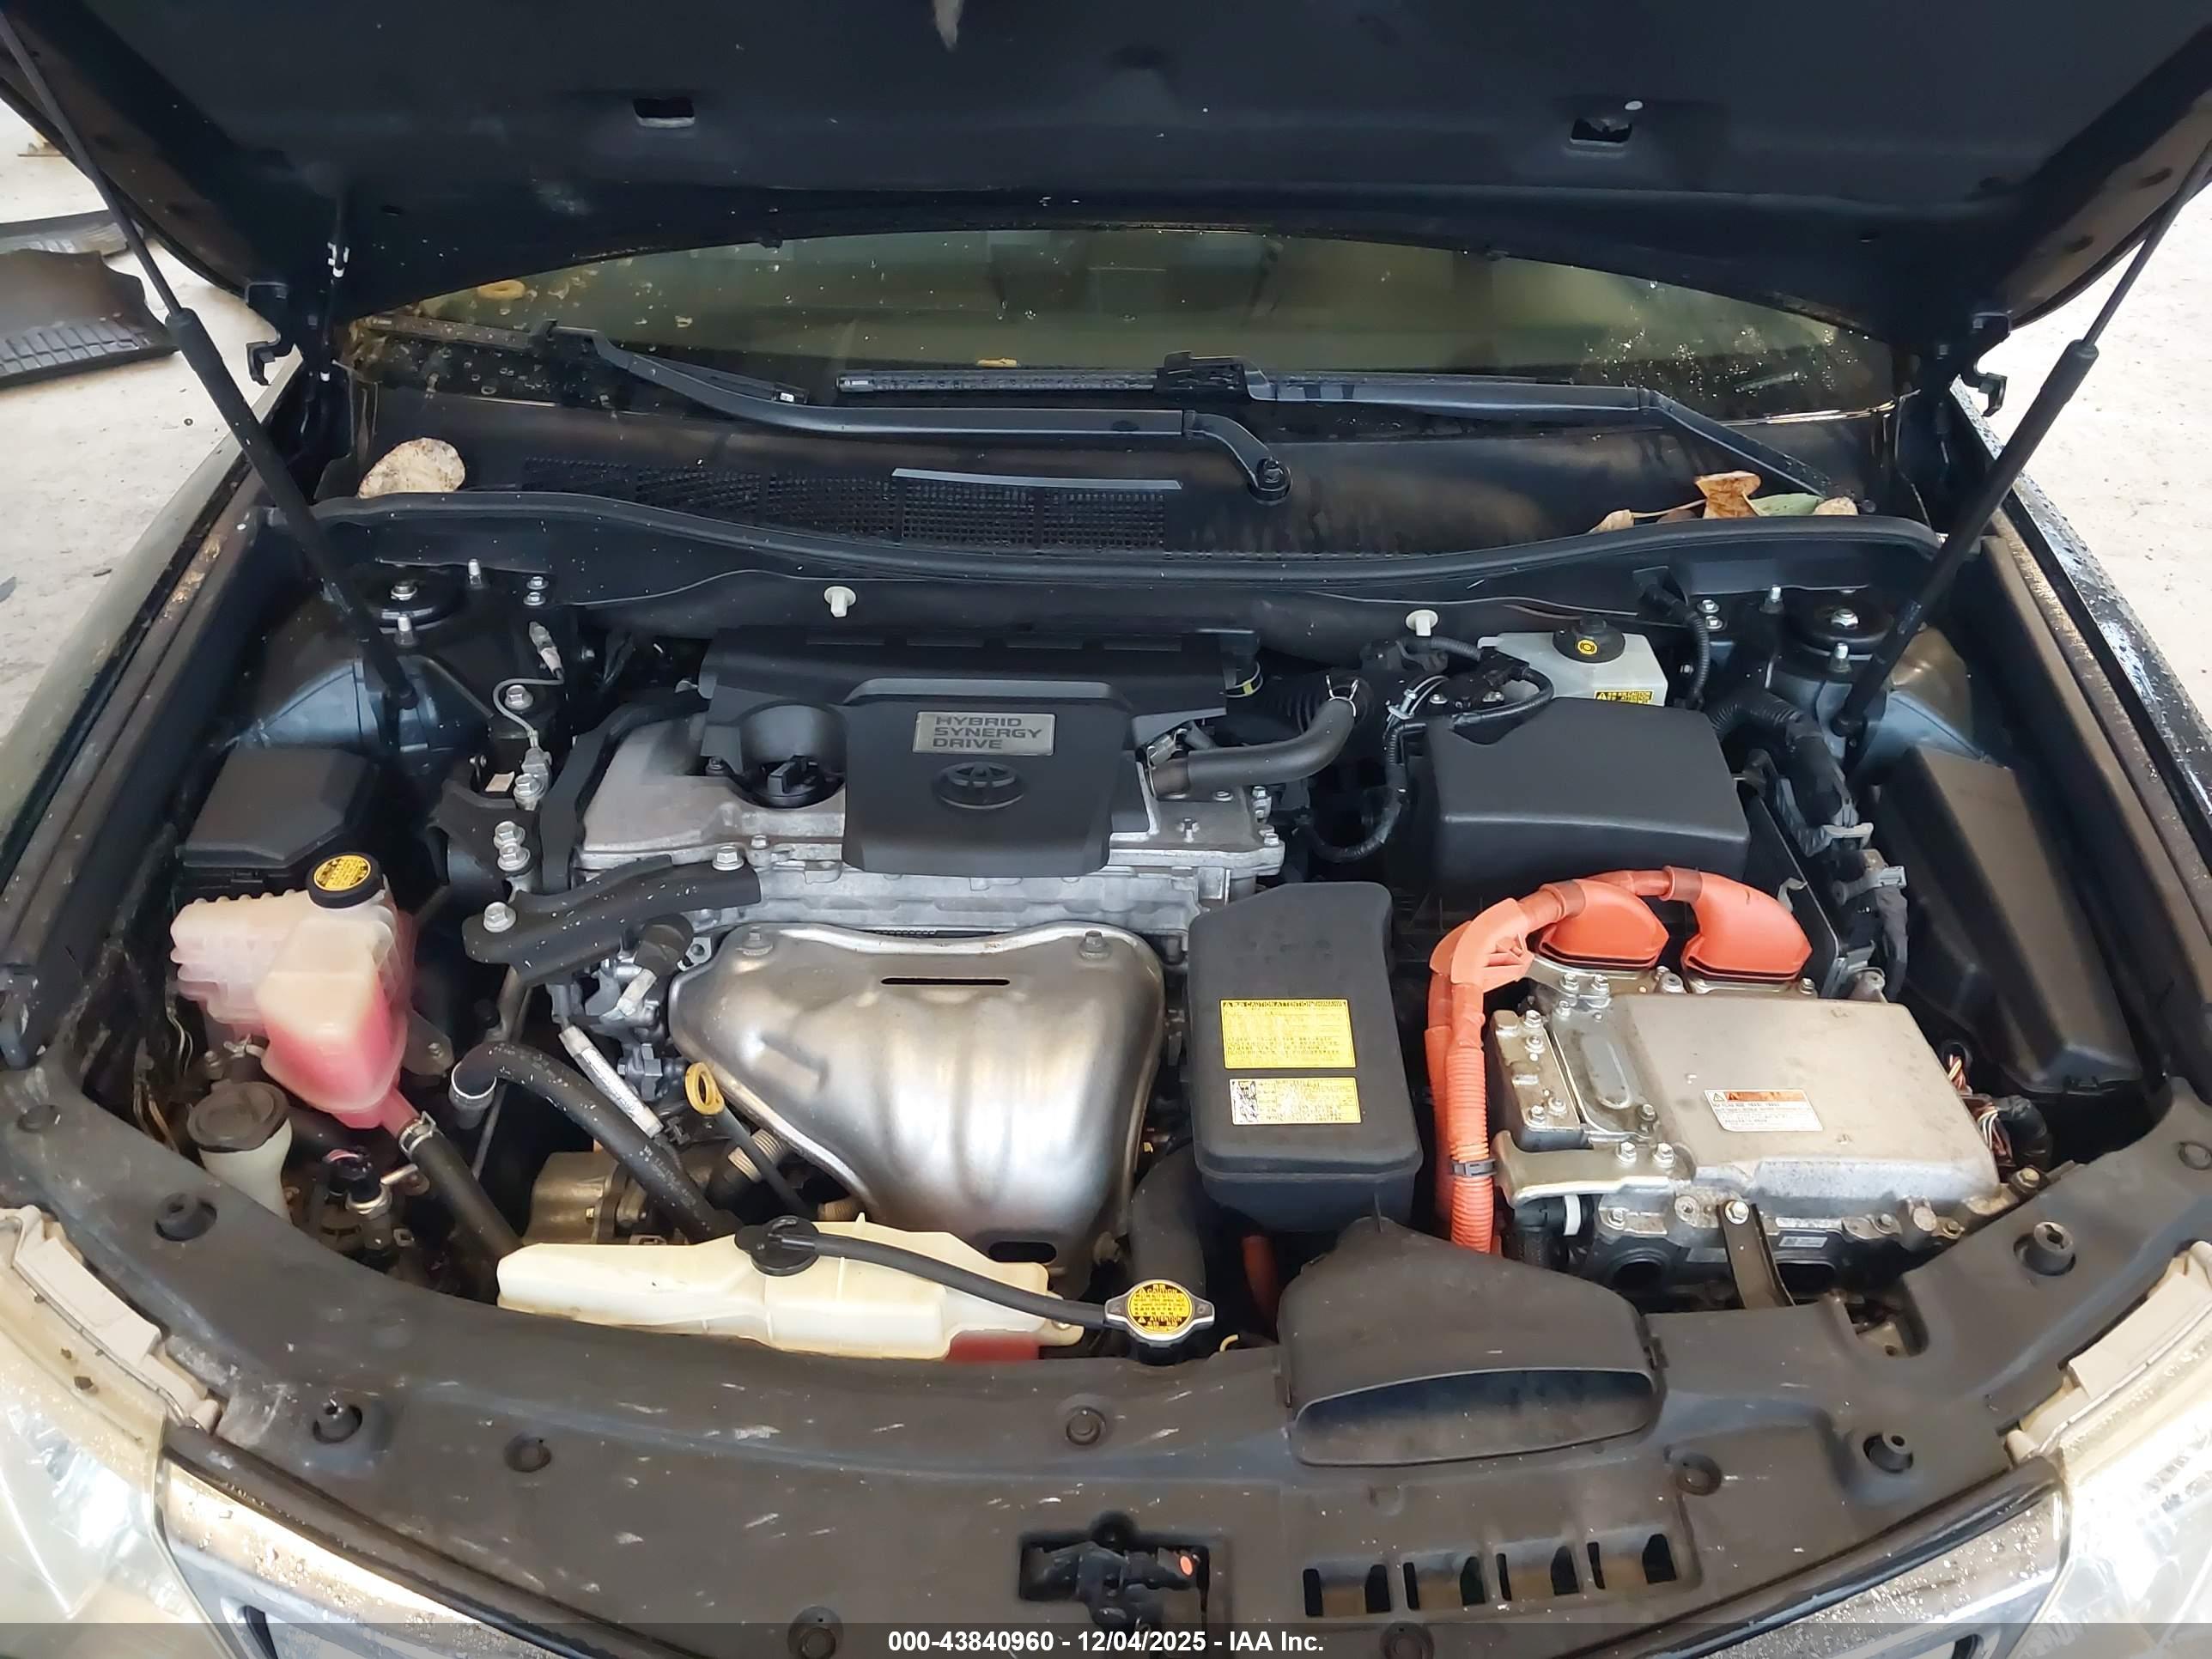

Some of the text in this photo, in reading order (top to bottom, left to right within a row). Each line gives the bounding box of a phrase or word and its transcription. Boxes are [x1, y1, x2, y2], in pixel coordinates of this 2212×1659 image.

[936, 716, 1022, 726] HYBRID
[933, 726, 1042, 738] SYNERGY
[933, 738, 1003, 750] DRIVE
